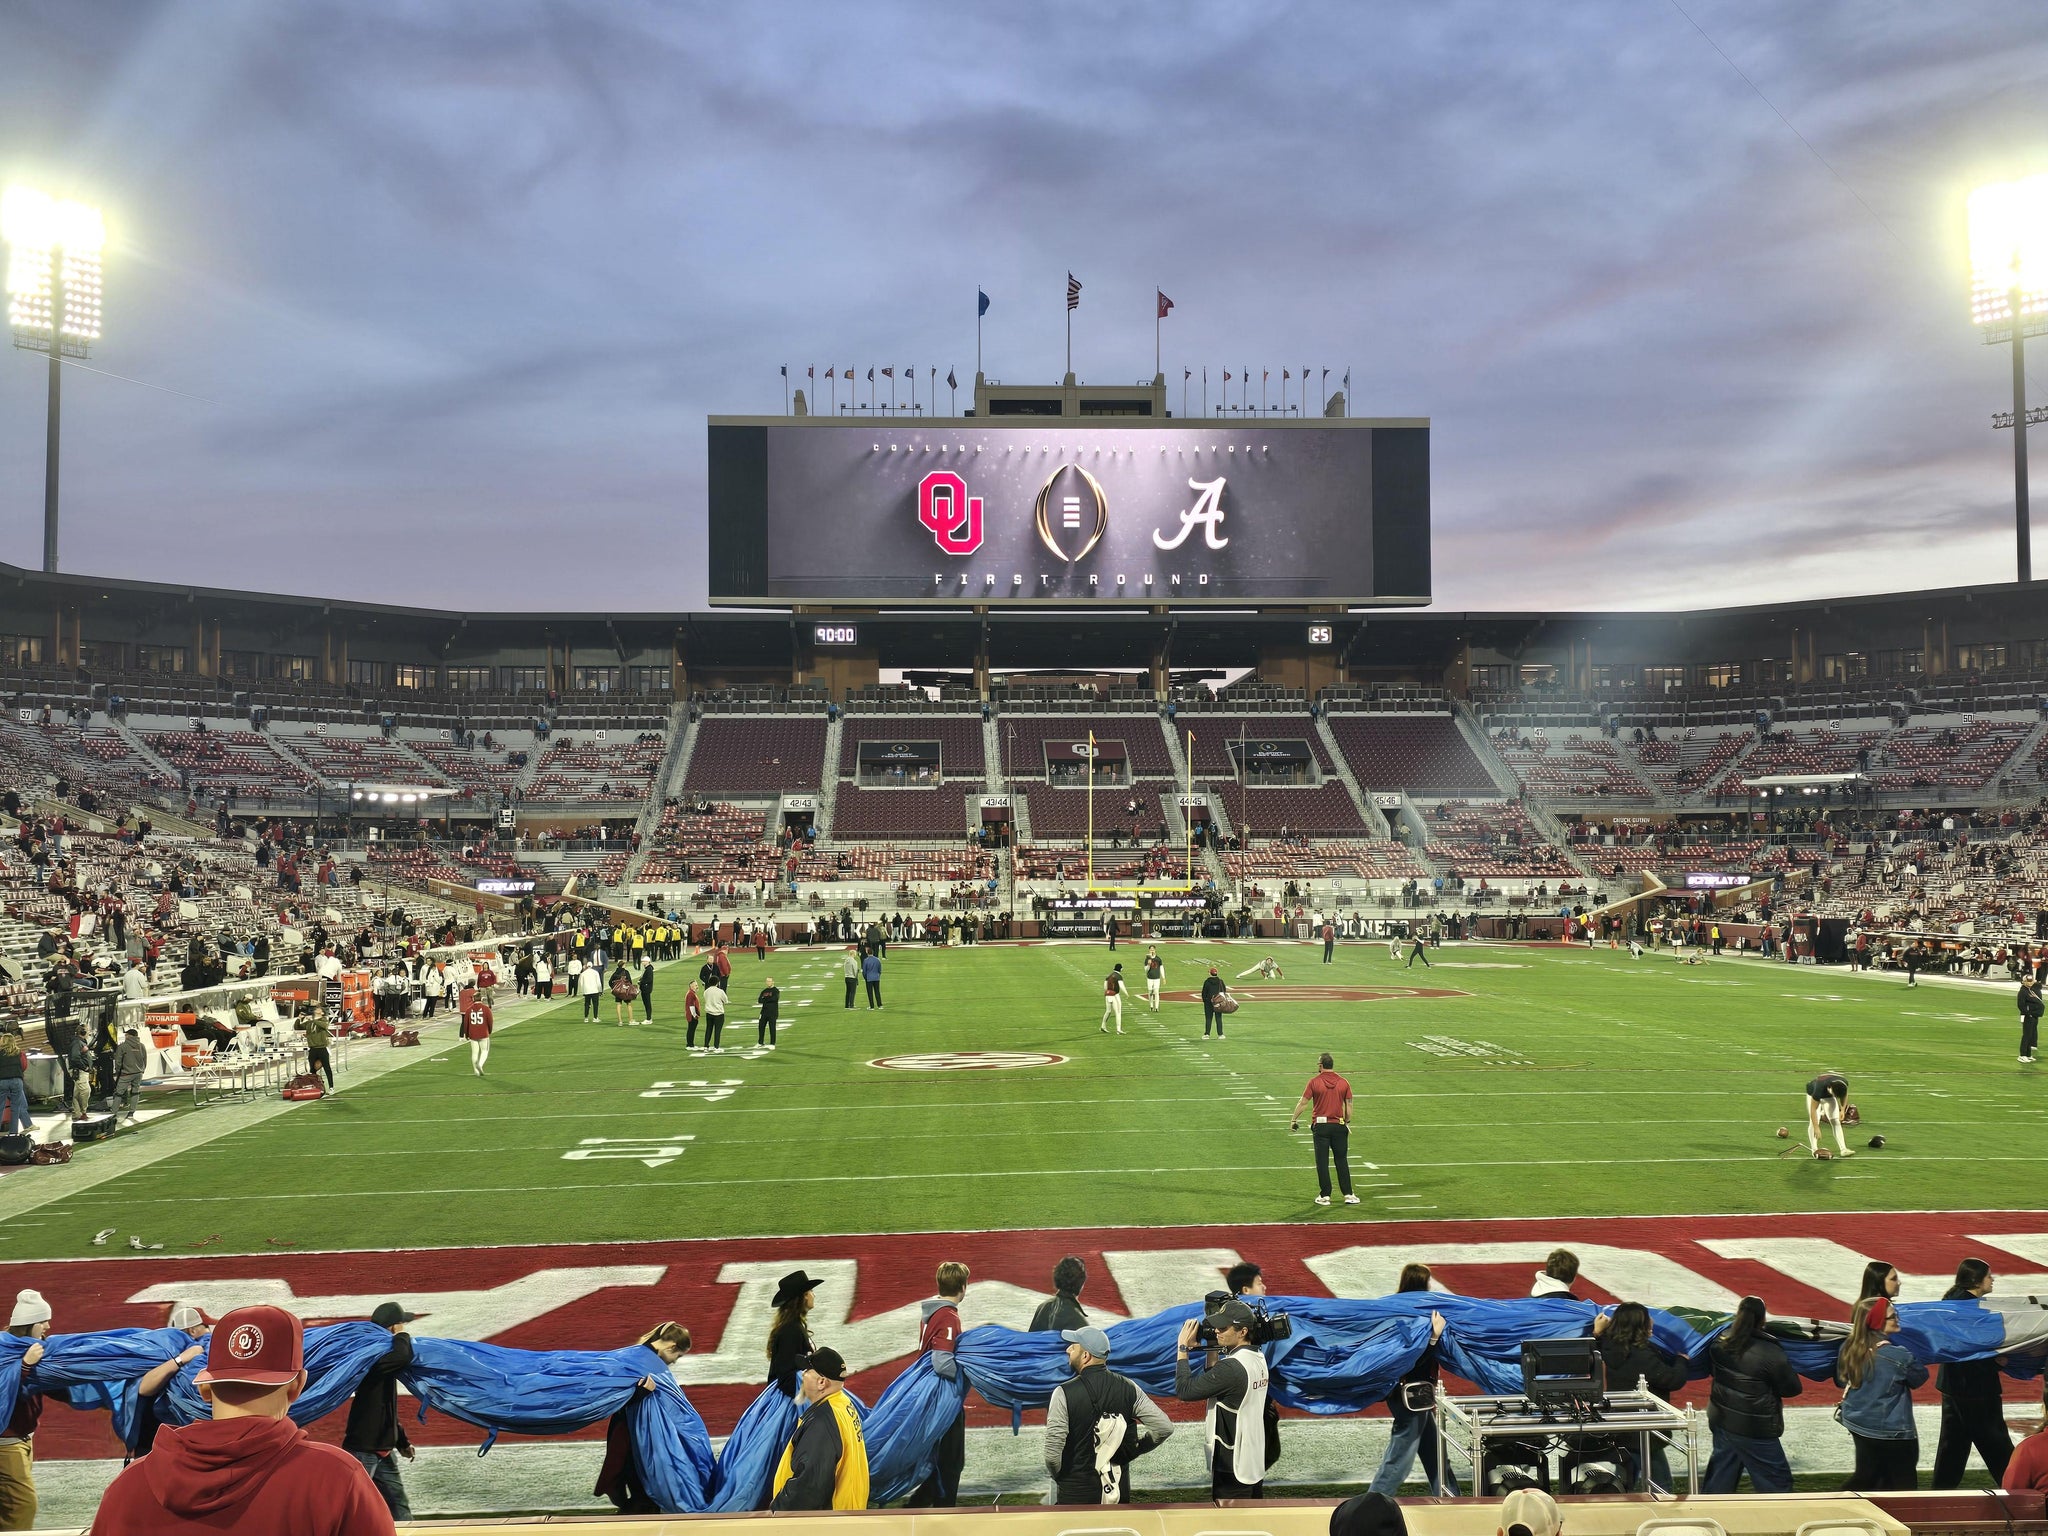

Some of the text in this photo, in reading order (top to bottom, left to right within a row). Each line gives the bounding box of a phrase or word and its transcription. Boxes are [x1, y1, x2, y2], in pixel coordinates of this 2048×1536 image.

[873, 444, 1268, 453] COLLEGE FOOTBALL PLAYOFF
[935, 574, 1208, 585] FIRST ROUND
[817, 628, 854, 642] 90:00
[1311, 628, 1329, 642] 25
[790, 799, 811, 807] 42/43
[985, 798, 1007, 806] 43/44
[1179, 797, 1202, 805] 44/45
[1375, 796, 1396, 805] 45/46
[470, 1011, 484, 1024] 95
[945, 1326, 952, 1341] 1
[239, 1333, 252, 1349] OU
